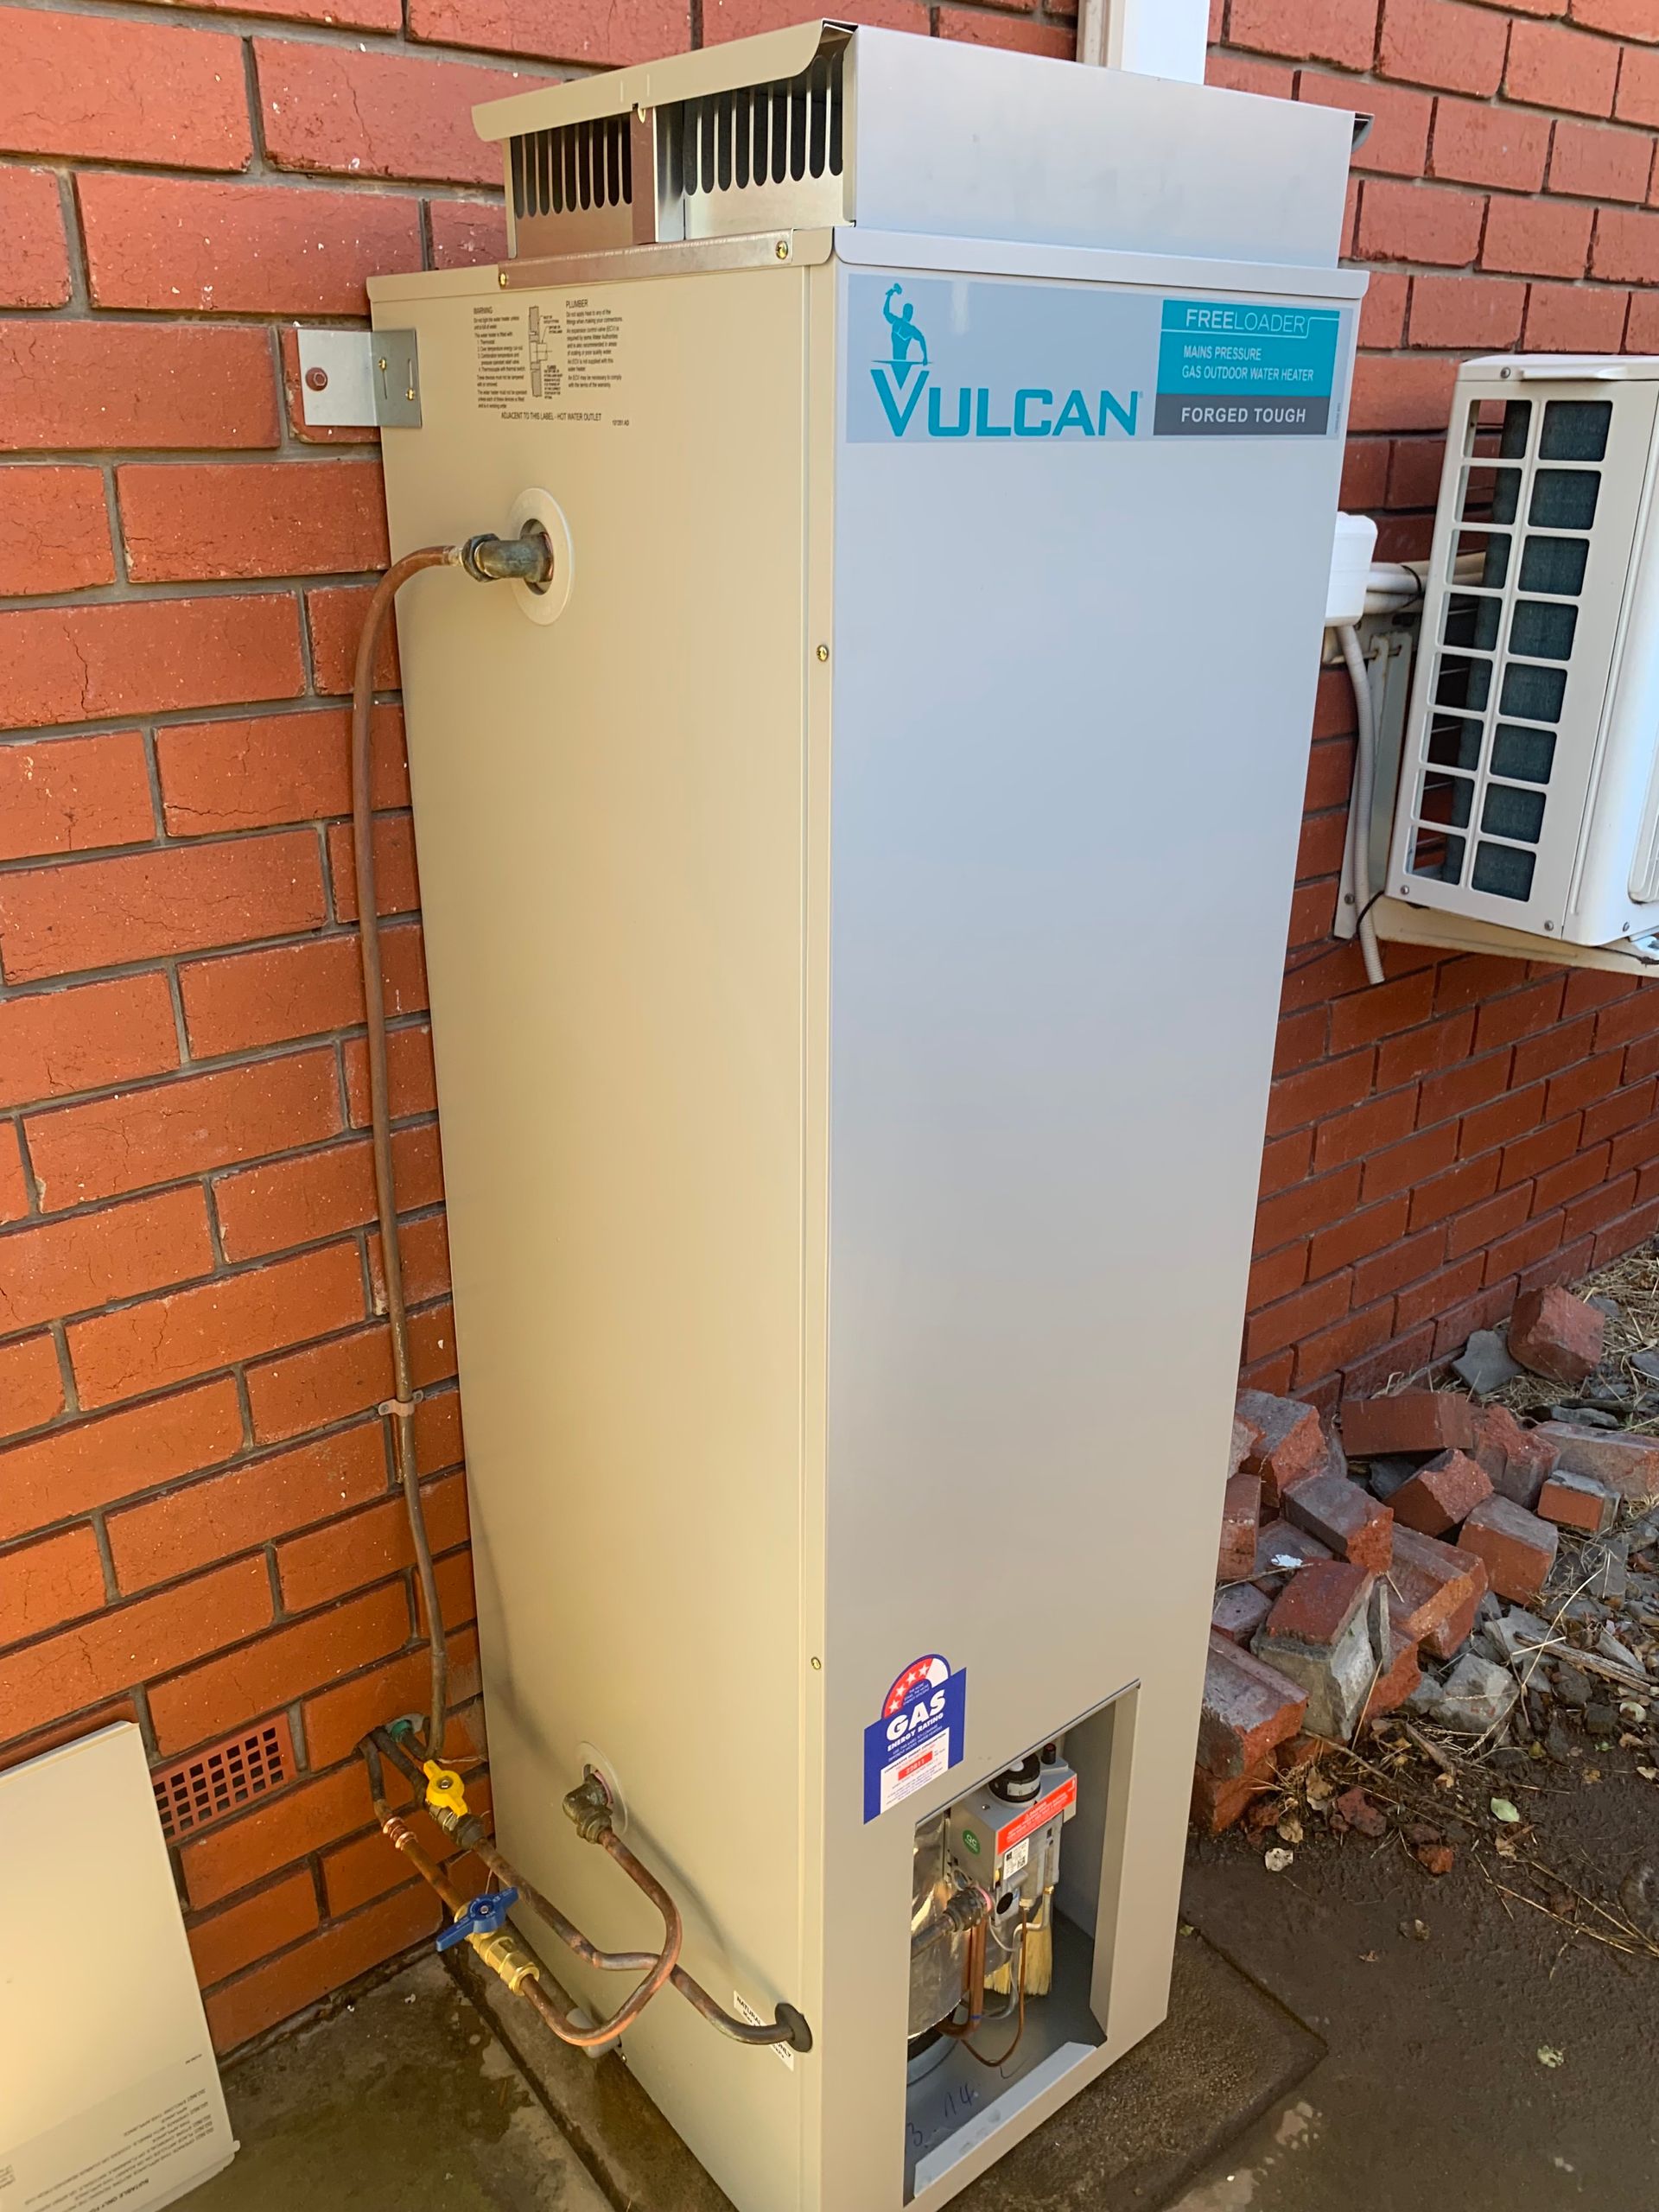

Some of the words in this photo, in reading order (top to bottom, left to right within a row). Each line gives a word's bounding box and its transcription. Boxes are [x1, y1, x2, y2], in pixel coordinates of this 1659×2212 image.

[566, 299, 588, 308] PLUMBER
[1185, 308, 1306, 334] FREELOADER
[1183, 345, 1212, 359] MAINS
[1214, 346, 1262, 361] PRESSURE
[1181, 365, 1202, 379] GAS
[1204, 365, 1248, 380] OUTDOOR
[1249, 366, 1280, 381] WATER
[1281, 368, 1314, 382] HEATER
[870, 369, 1139, 438] VULCAN
[584, 413, 601, 422] OUTLET
[1181, 407, 1249, 423] FORGED
[1254, 408, 1306, 423] TOUGH
[887, 1689, 945, 1741] GAS
[887, 1729, 917, 1751] ENERGY
[918, 1713, 944, 1732] RATING
